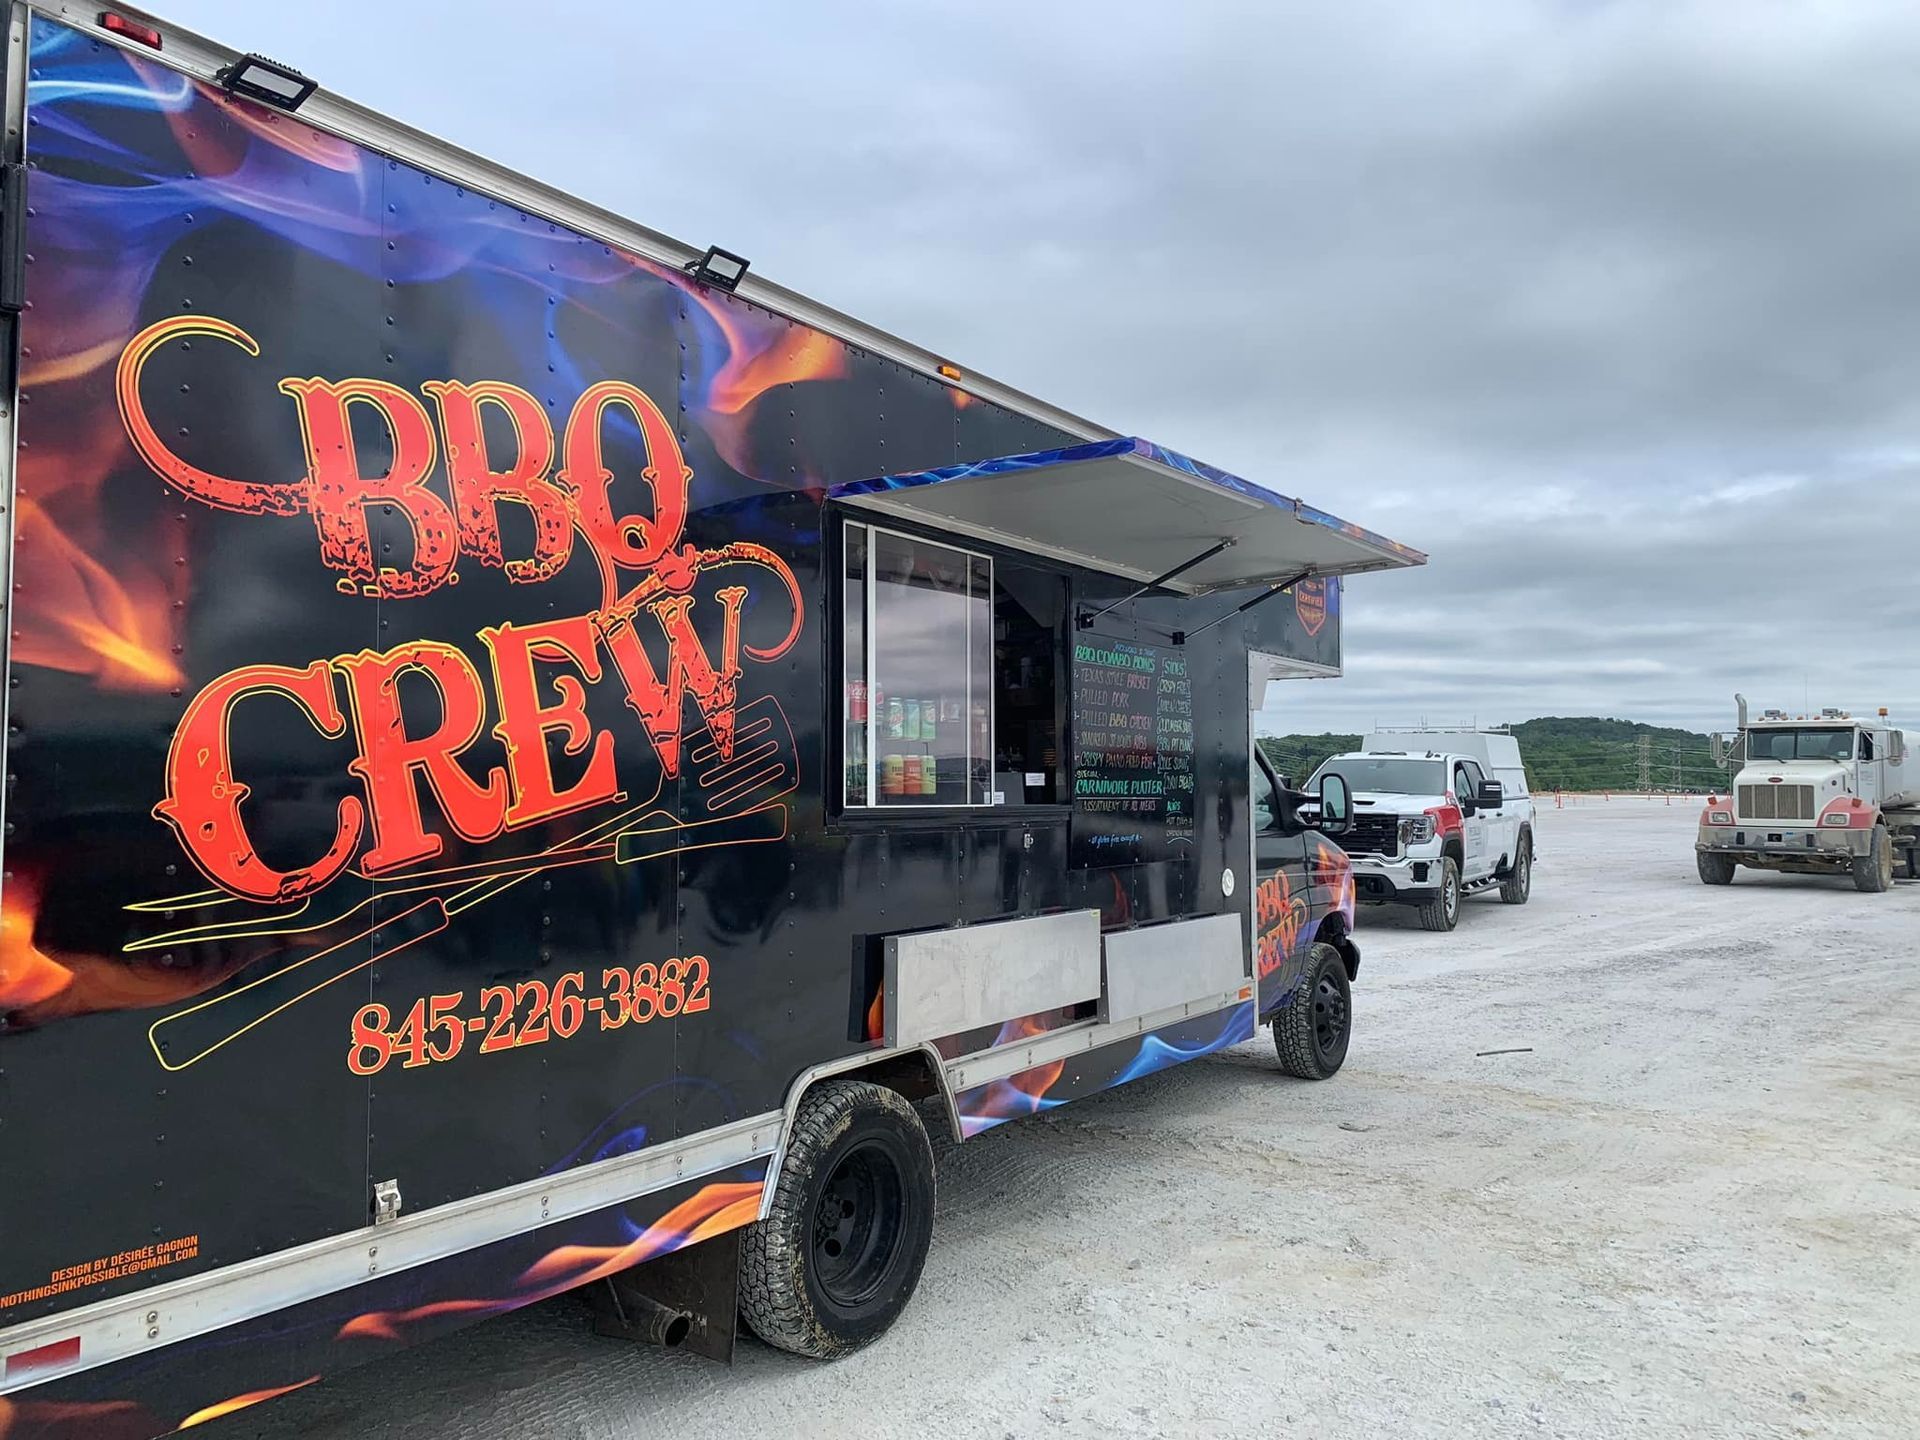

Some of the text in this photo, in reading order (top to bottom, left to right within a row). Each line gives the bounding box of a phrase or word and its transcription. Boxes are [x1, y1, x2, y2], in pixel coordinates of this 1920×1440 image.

[278, 377, 694, 599] BBQ
[1075, 645, 1096, 661] BBQ
[1097, 650, 1131, 668] COMBO
[1080, 668, 1104, 684] TEXAS
[1081, 688, 1130, 708] PULLED PORK
[1081, 709, 1108, 727] PULLED
[1109, 713, 1127, 728] BBQ
[152, 586, 748, 904] CREW
[1080, 751, 1104, 767] CRISPY
[1075, 777, 1162, 795] CARNIVORE PLATTER
[347, 955, 711, 1076] 845-226-3882
[51, 1262, 91, 1283] DESIGN
[94, 1257, 108, 1270] BY
[156, 1234, 198, 1254] GAGNON
[0, 1246, 198, 1309] NOTHINGSINKPOSSIBLE@GMAIL.COM
